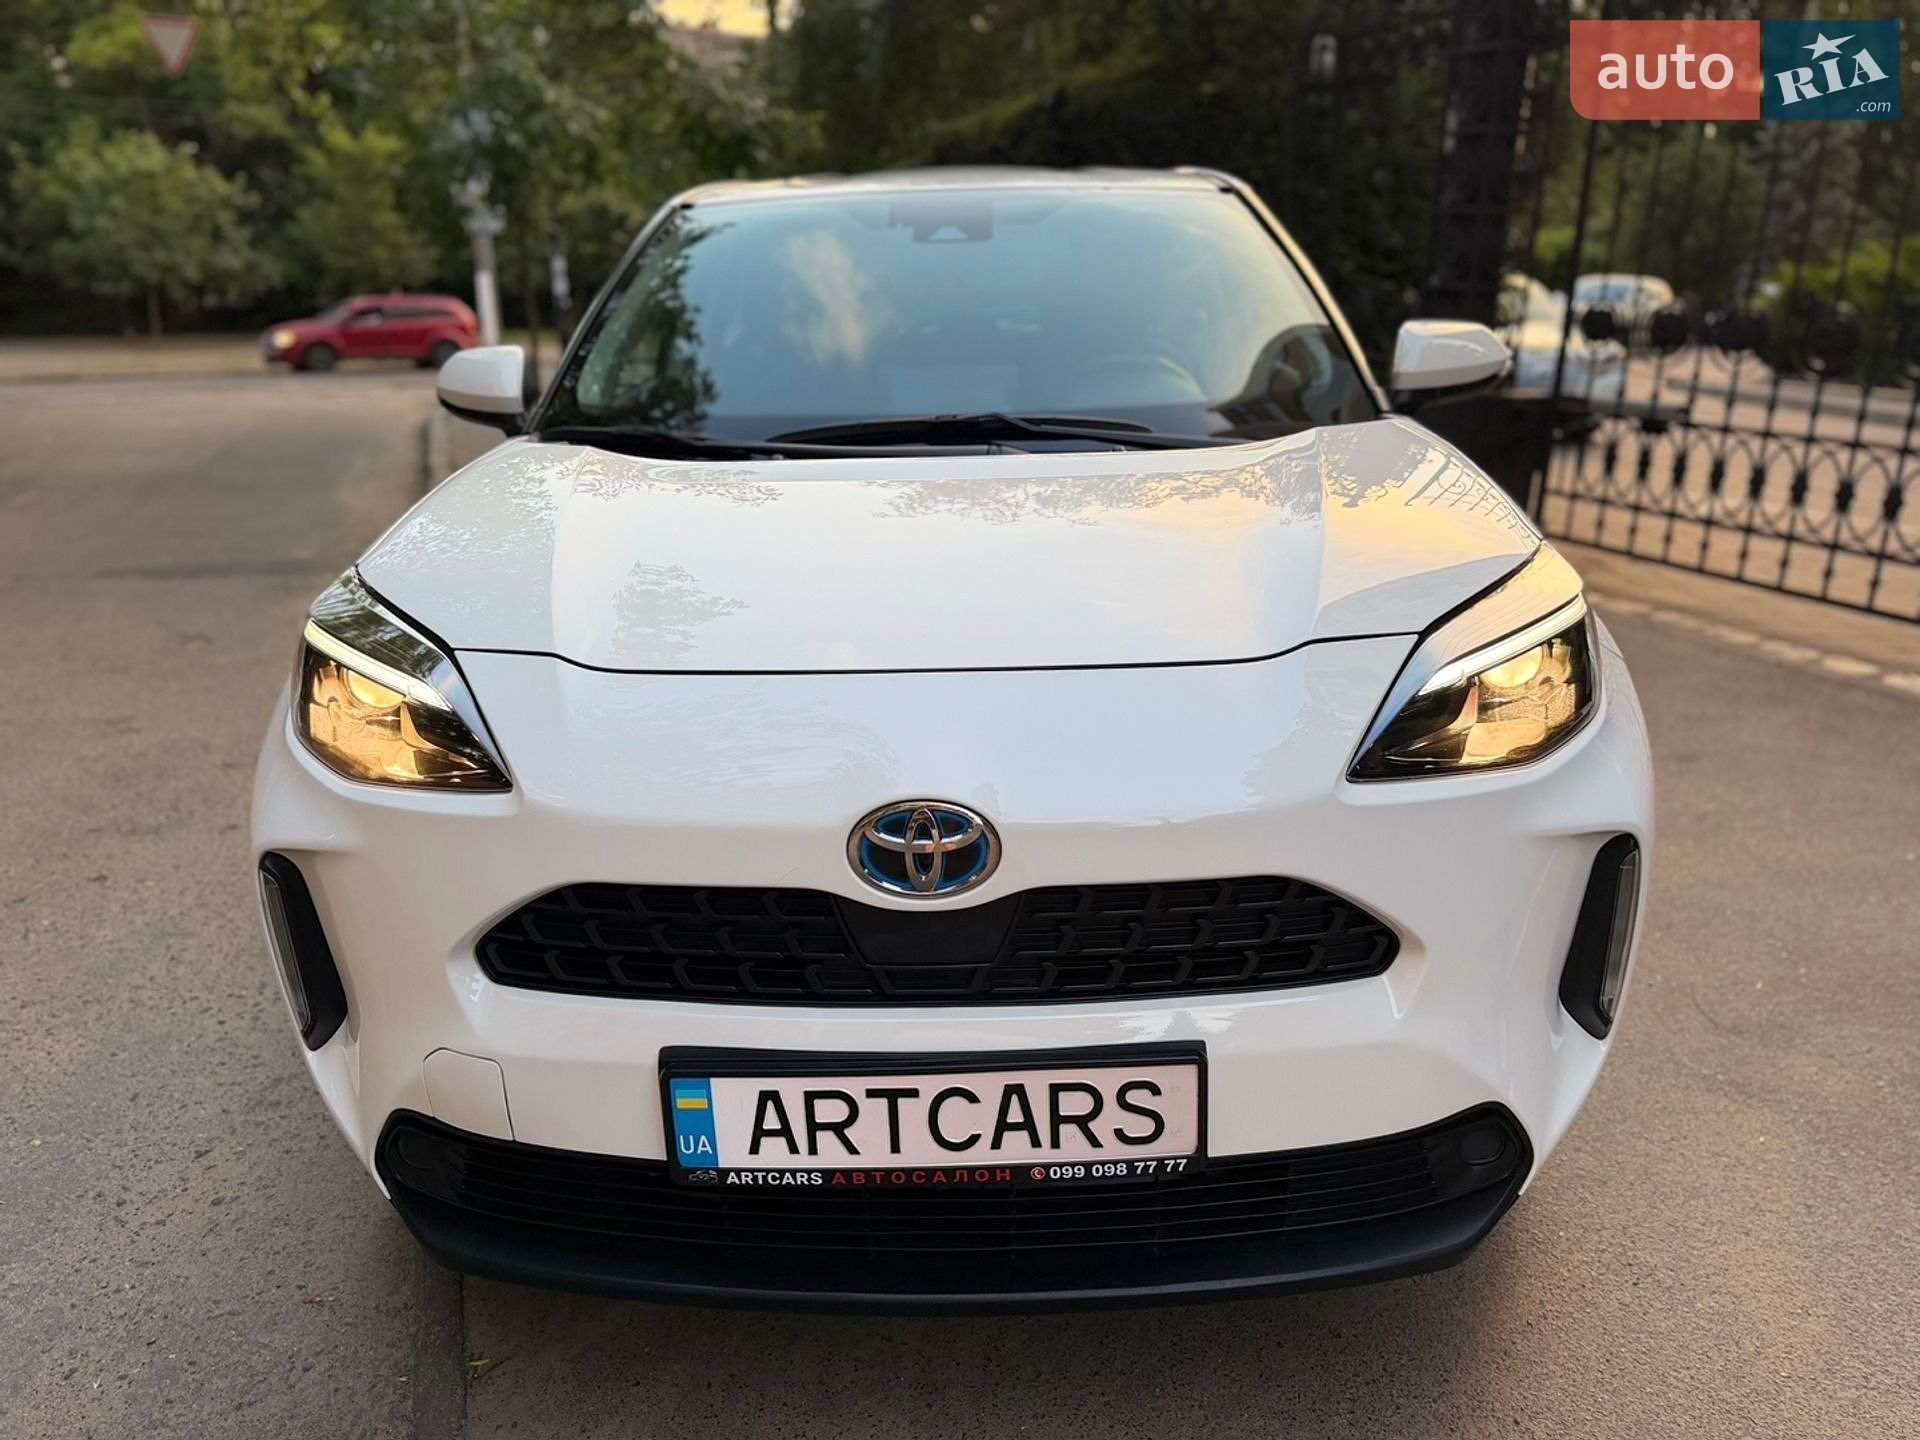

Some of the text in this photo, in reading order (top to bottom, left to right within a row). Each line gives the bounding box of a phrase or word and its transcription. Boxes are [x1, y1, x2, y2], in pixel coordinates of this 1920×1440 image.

[748, 1079, 1165, 1156] ARTCARS
[679, 1134, 713, 1155] UA
[726, 1158, 1189, 1186] ARTCARS АВТОСАЛОН 099 098 77 77
